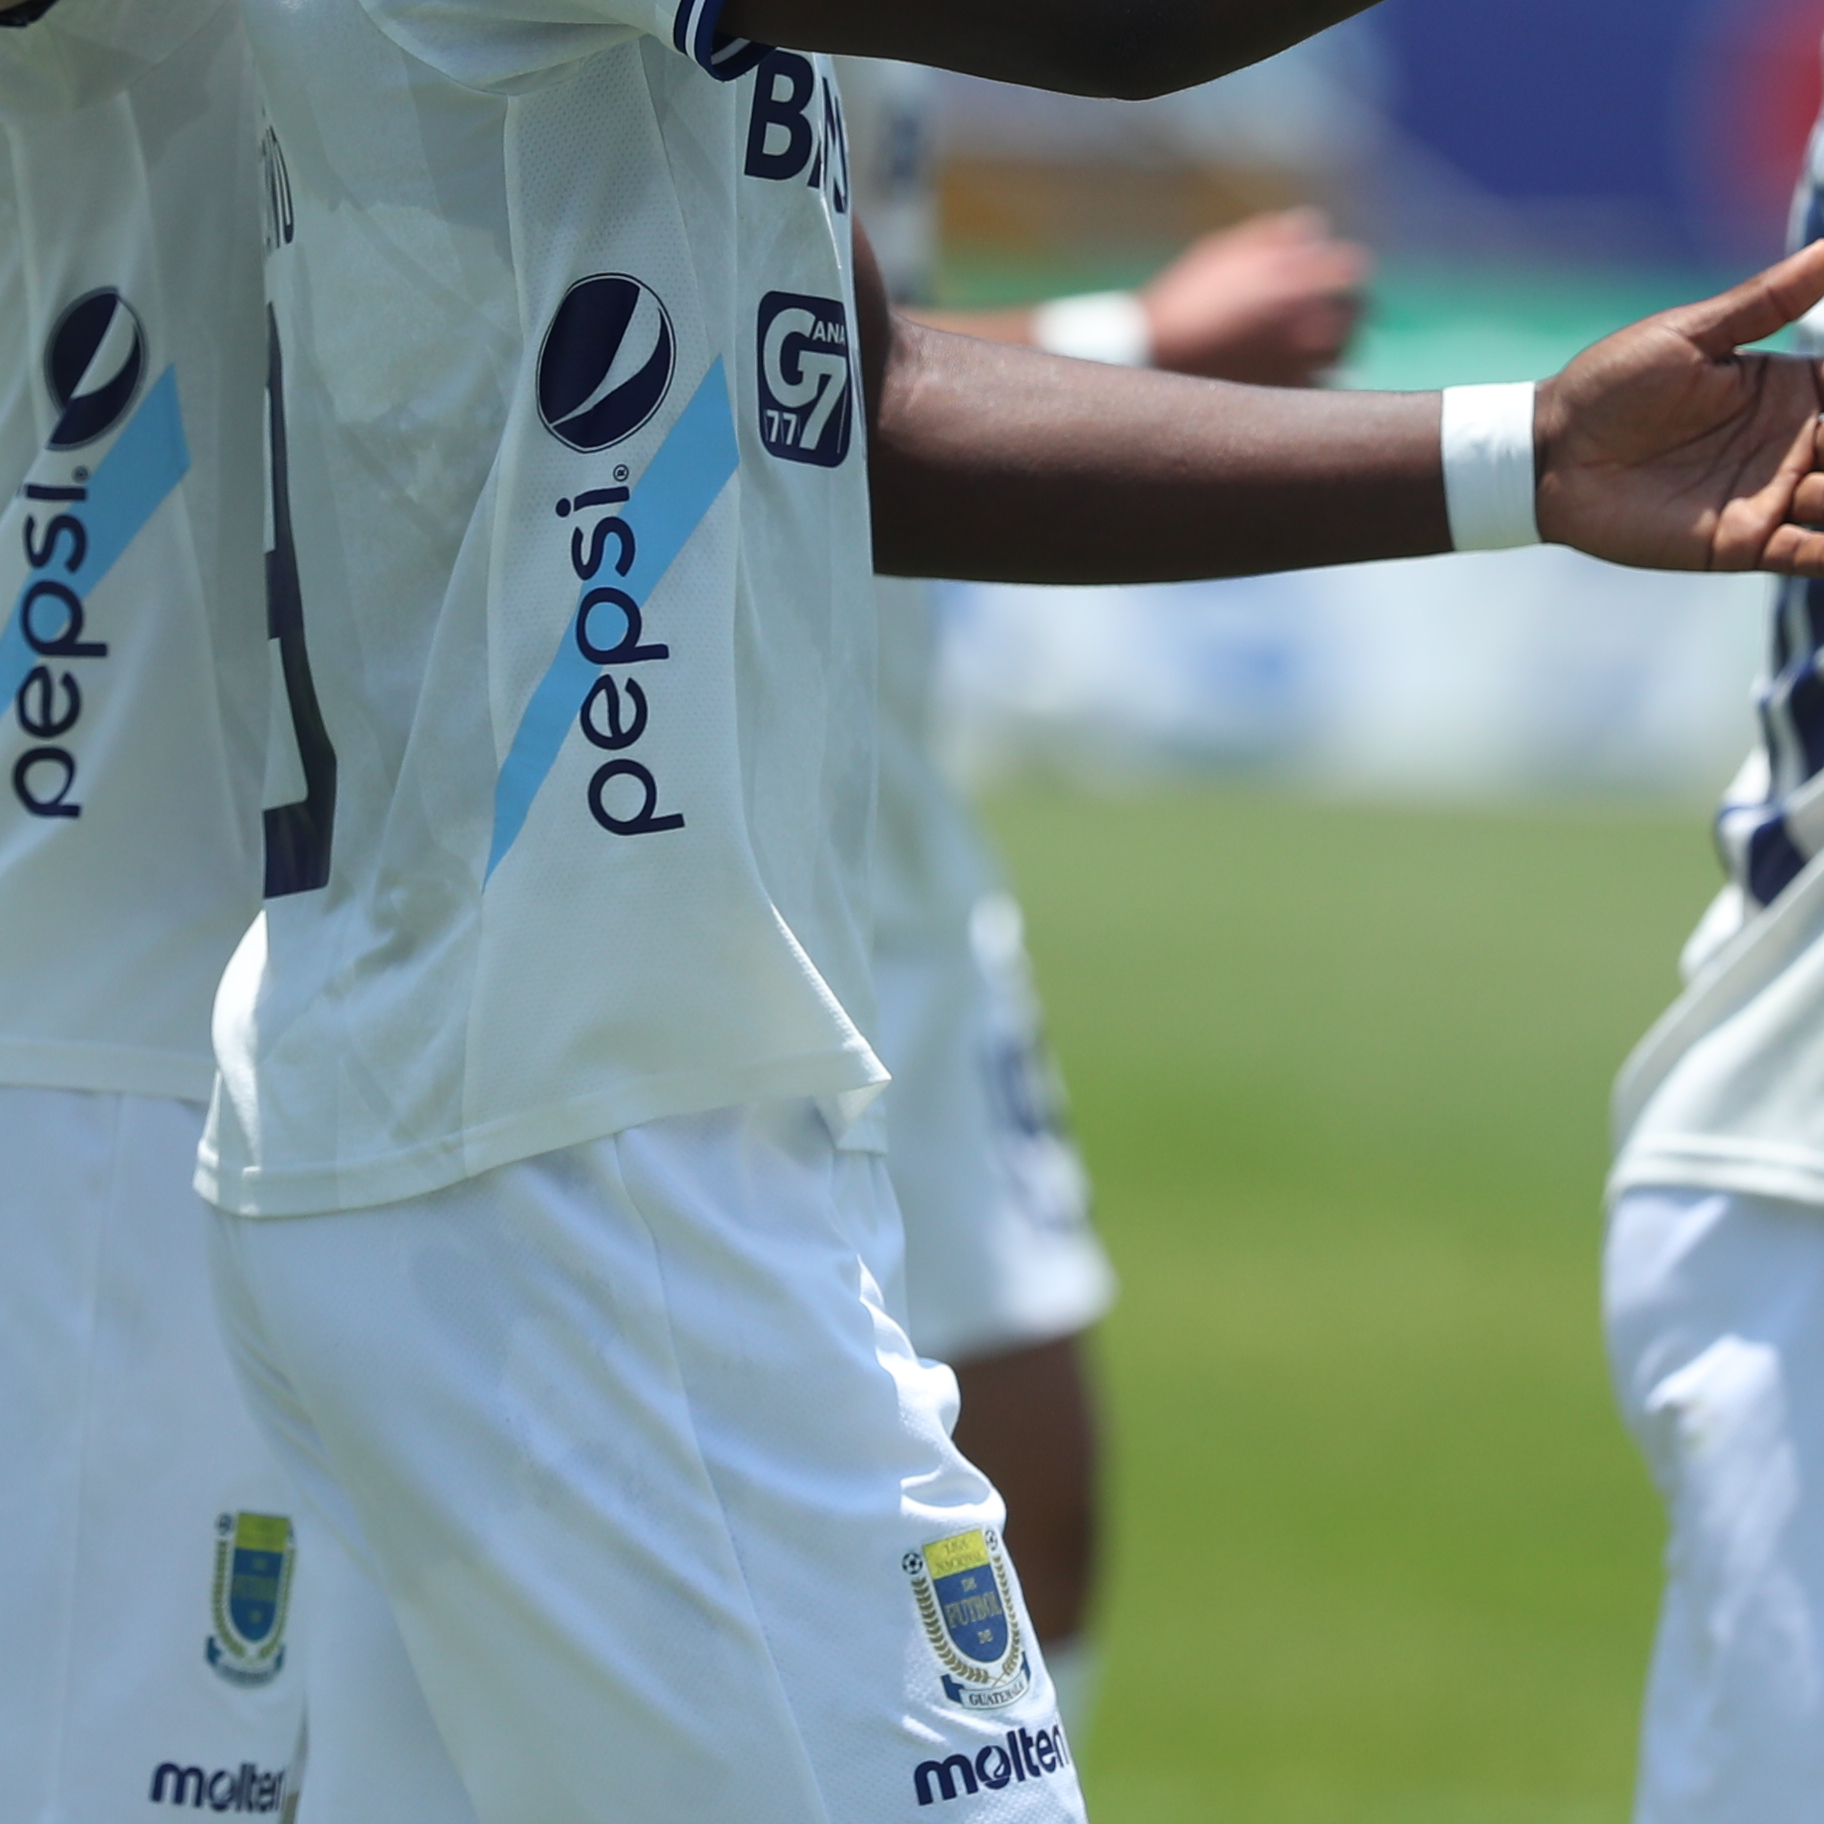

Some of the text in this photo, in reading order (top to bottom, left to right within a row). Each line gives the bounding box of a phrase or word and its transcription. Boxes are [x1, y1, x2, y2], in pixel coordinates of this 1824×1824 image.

[11, 483, 108, 819] pepsi
[555, 486, 685, 836] pepsi
[914, 1723, 1068, 1806] molten
